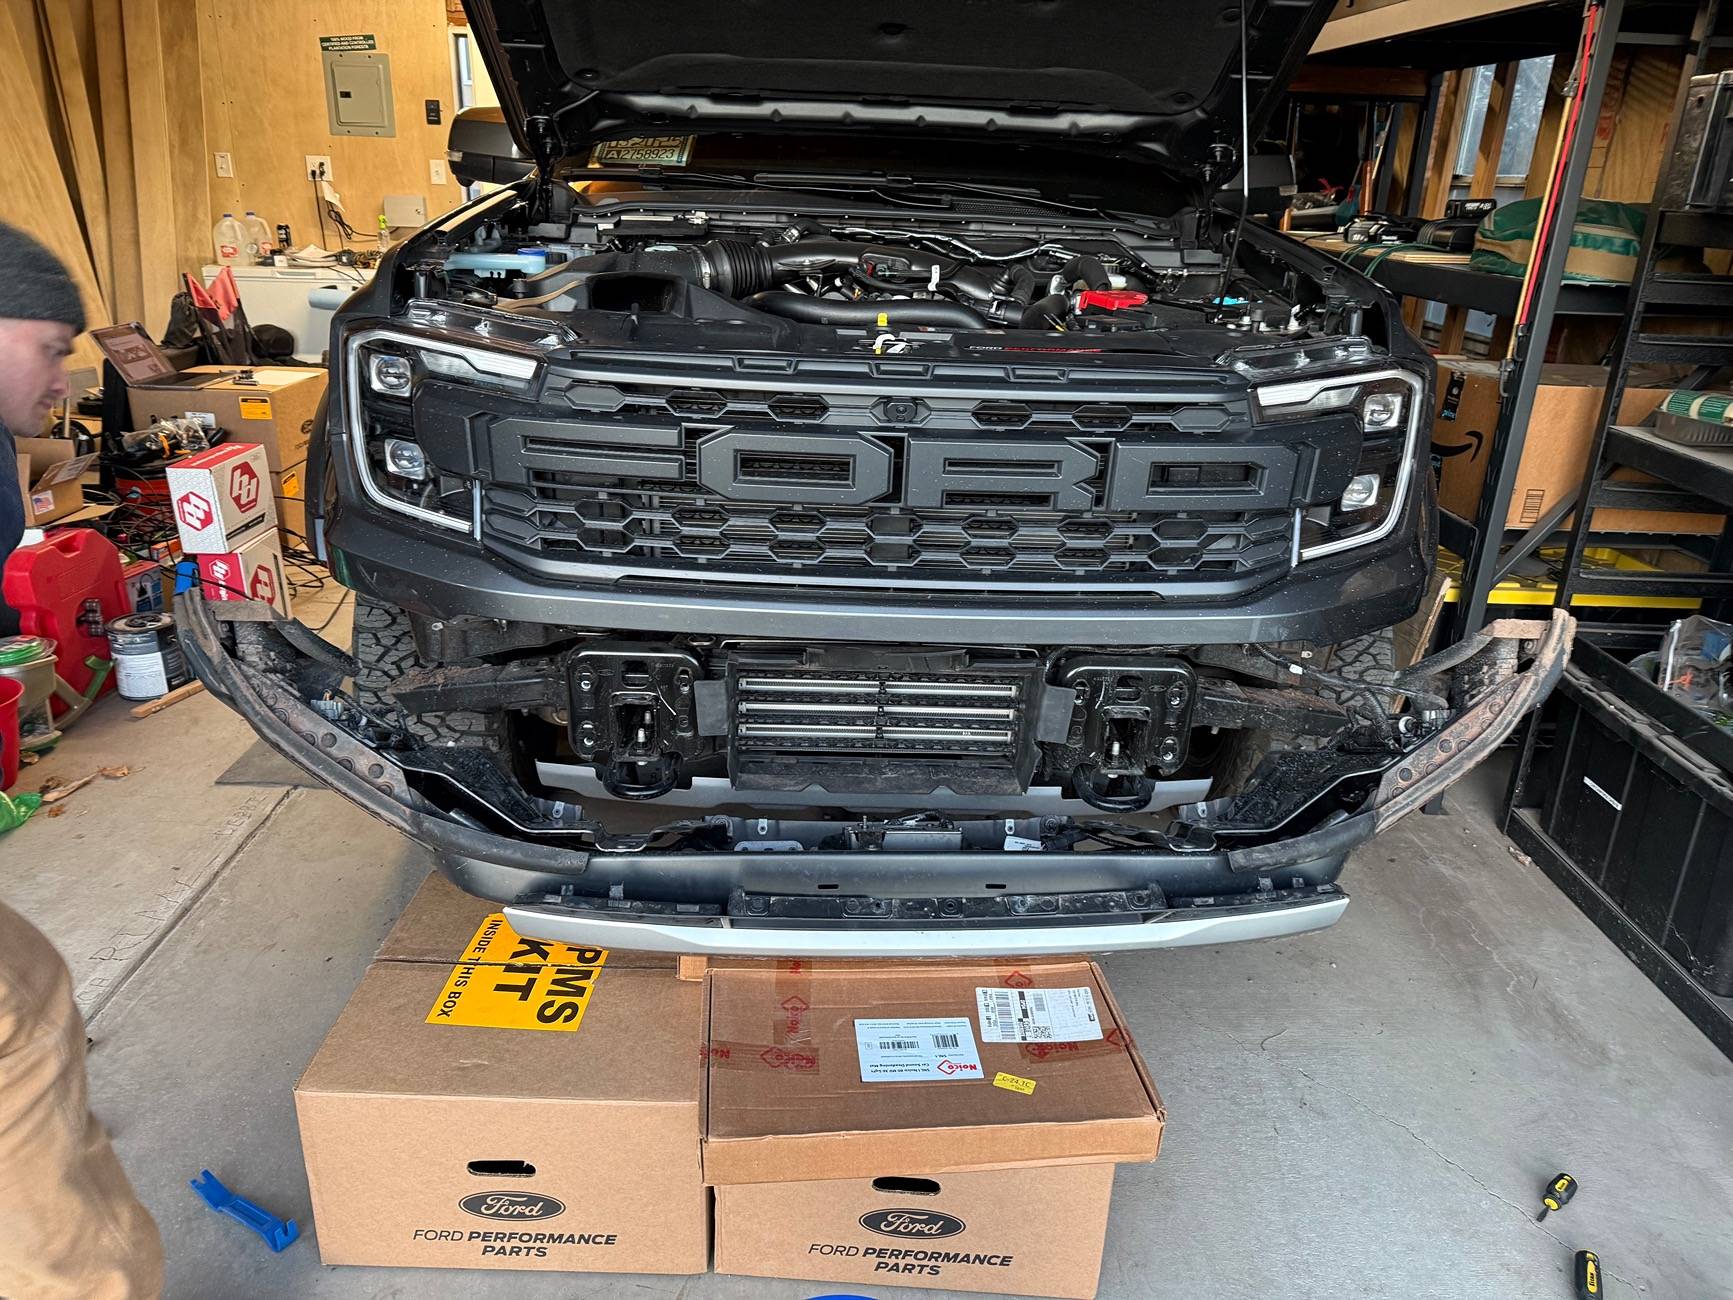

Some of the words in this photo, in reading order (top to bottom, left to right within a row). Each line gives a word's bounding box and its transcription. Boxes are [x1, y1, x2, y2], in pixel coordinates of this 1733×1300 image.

[488, 415, 1298, 511] FORD
[471, 919, 503, 954] INSIDE
[454, 956, 482, 988] THIS
[493, 937, 555, 1002] KIT
[437, 991, 462, 1018] BOX
[946, 1062, 978, 1072] Noico
[480, 1194, 543, 1217] Ford
[880, 1212, 945, 1236] Ford
[413, 1229, 464, 1242] FORD
[467, 1231, 618, 1246] PERFORMANCE
[481, 1245, 548, 1258] PARTS
[808, 1243, 860, 1257] FORD
[862, 1247, 1014, 1267] PERFORMANCE
[874, 1261, 942, 1276] PARTS
